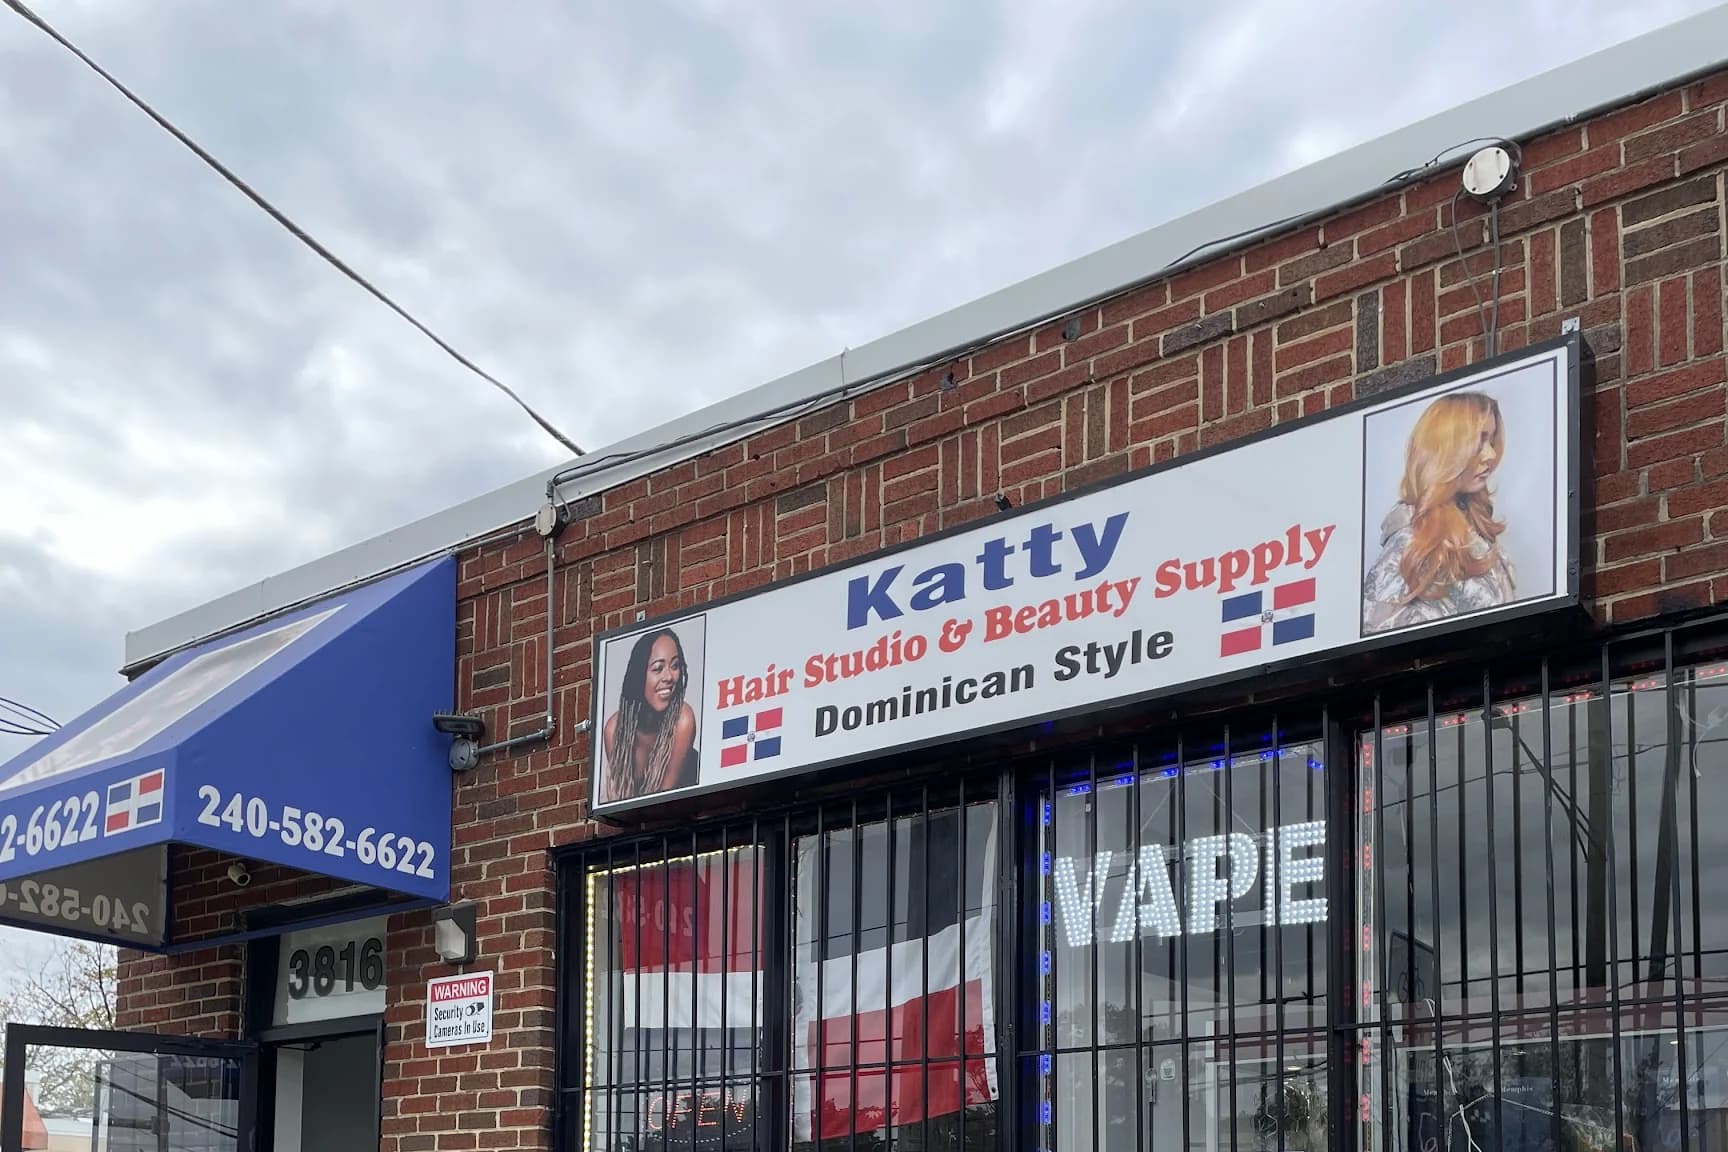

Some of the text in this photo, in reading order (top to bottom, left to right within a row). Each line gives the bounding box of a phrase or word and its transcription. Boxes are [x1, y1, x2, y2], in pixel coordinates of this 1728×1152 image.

[716, 523, 1337, 710] Hair Studio & Beauty Supply
[847, 511, 1130, 631] Katty
[814, 629, 1175, 738] Dominican Style
[198, 785, 436, 880] 240-582-6622
[1054, 820, 1328, 947] VAPE
[288, 938, 384, 999] 3816
[434, 979, 487, 1001] WARNING
[434, 1004, 464, 1021] Security
[433, 1019, 485, 1038] Cameras In Use
